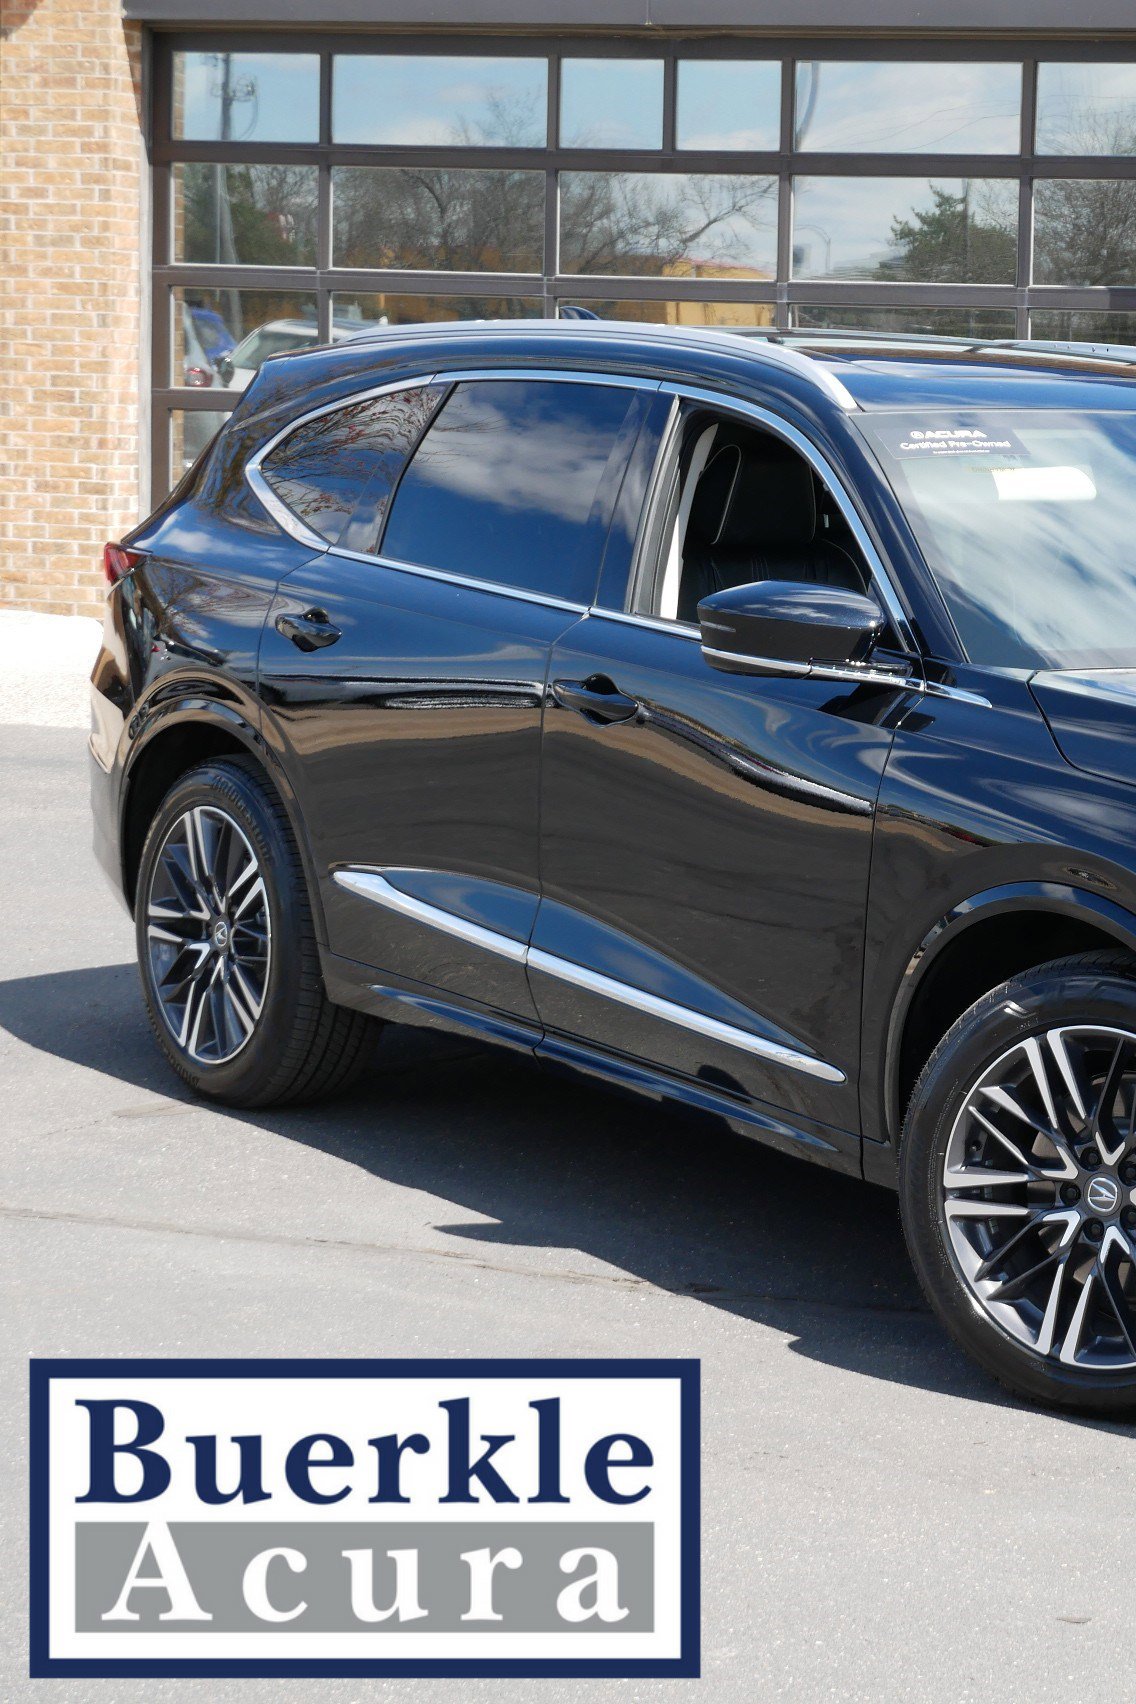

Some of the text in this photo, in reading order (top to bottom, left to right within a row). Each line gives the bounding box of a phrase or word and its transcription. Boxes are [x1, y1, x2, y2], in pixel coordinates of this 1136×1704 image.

[924, 430, 987, 439] ACURA
[899, 440, 1011, 450] Certified Pre-Owned
